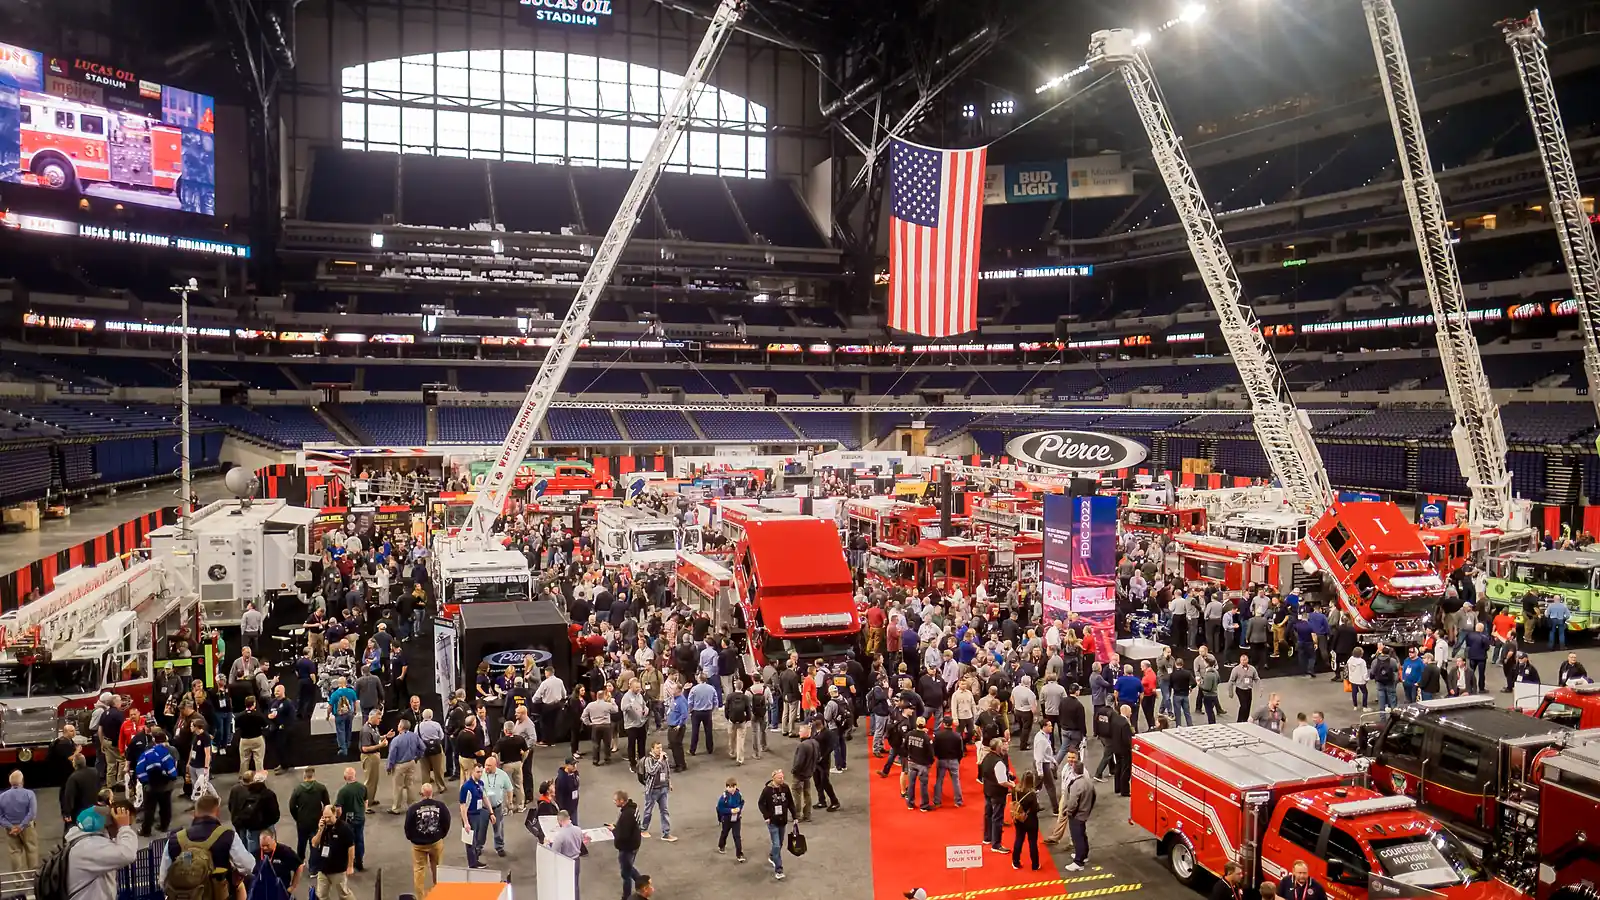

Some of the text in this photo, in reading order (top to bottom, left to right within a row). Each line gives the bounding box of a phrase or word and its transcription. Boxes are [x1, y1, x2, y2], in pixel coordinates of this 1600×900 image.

[581, 0, 612, 15] OIL
[536, 9, 597, 26] STADIUM
[74, 58, 113, 77] LUCAS
[115, 69, 136, 82] OIL
[85, 72, 126, 89] STADIUM
[52, 80, 98, 99] meijer
[84, 144, 104, 158] 31
[1019, 170, 1052, 184] BUD
[1013, 182, 1059, 196] LIGHT
[79, 224, 110, 239] LUCAS
[112, 229, 128, 241] OIL
[129, 231, 169, 247] STADIUM
[237, 246, 246, 257] IN
[984, 269, 1017, 279] STADIUM
[1080, 266, 1089, 275] IN
[1484, 308, 1502, 318] AREA
[1368, 318, 1387, 328] FRIDAY
[1403, 316, 1411, 326] AT
[498, 401, 537, 467] WEST DES MOINES
[1080, 500, 1091, 557] FDIC 2022
[498, 652, 536, 664] Piere
[1380, 843, 1433, 858] COURTESY OF
[1392, 853, 1433, 865] NATIONAL
[1410, 861, 1429, 872] CITY
